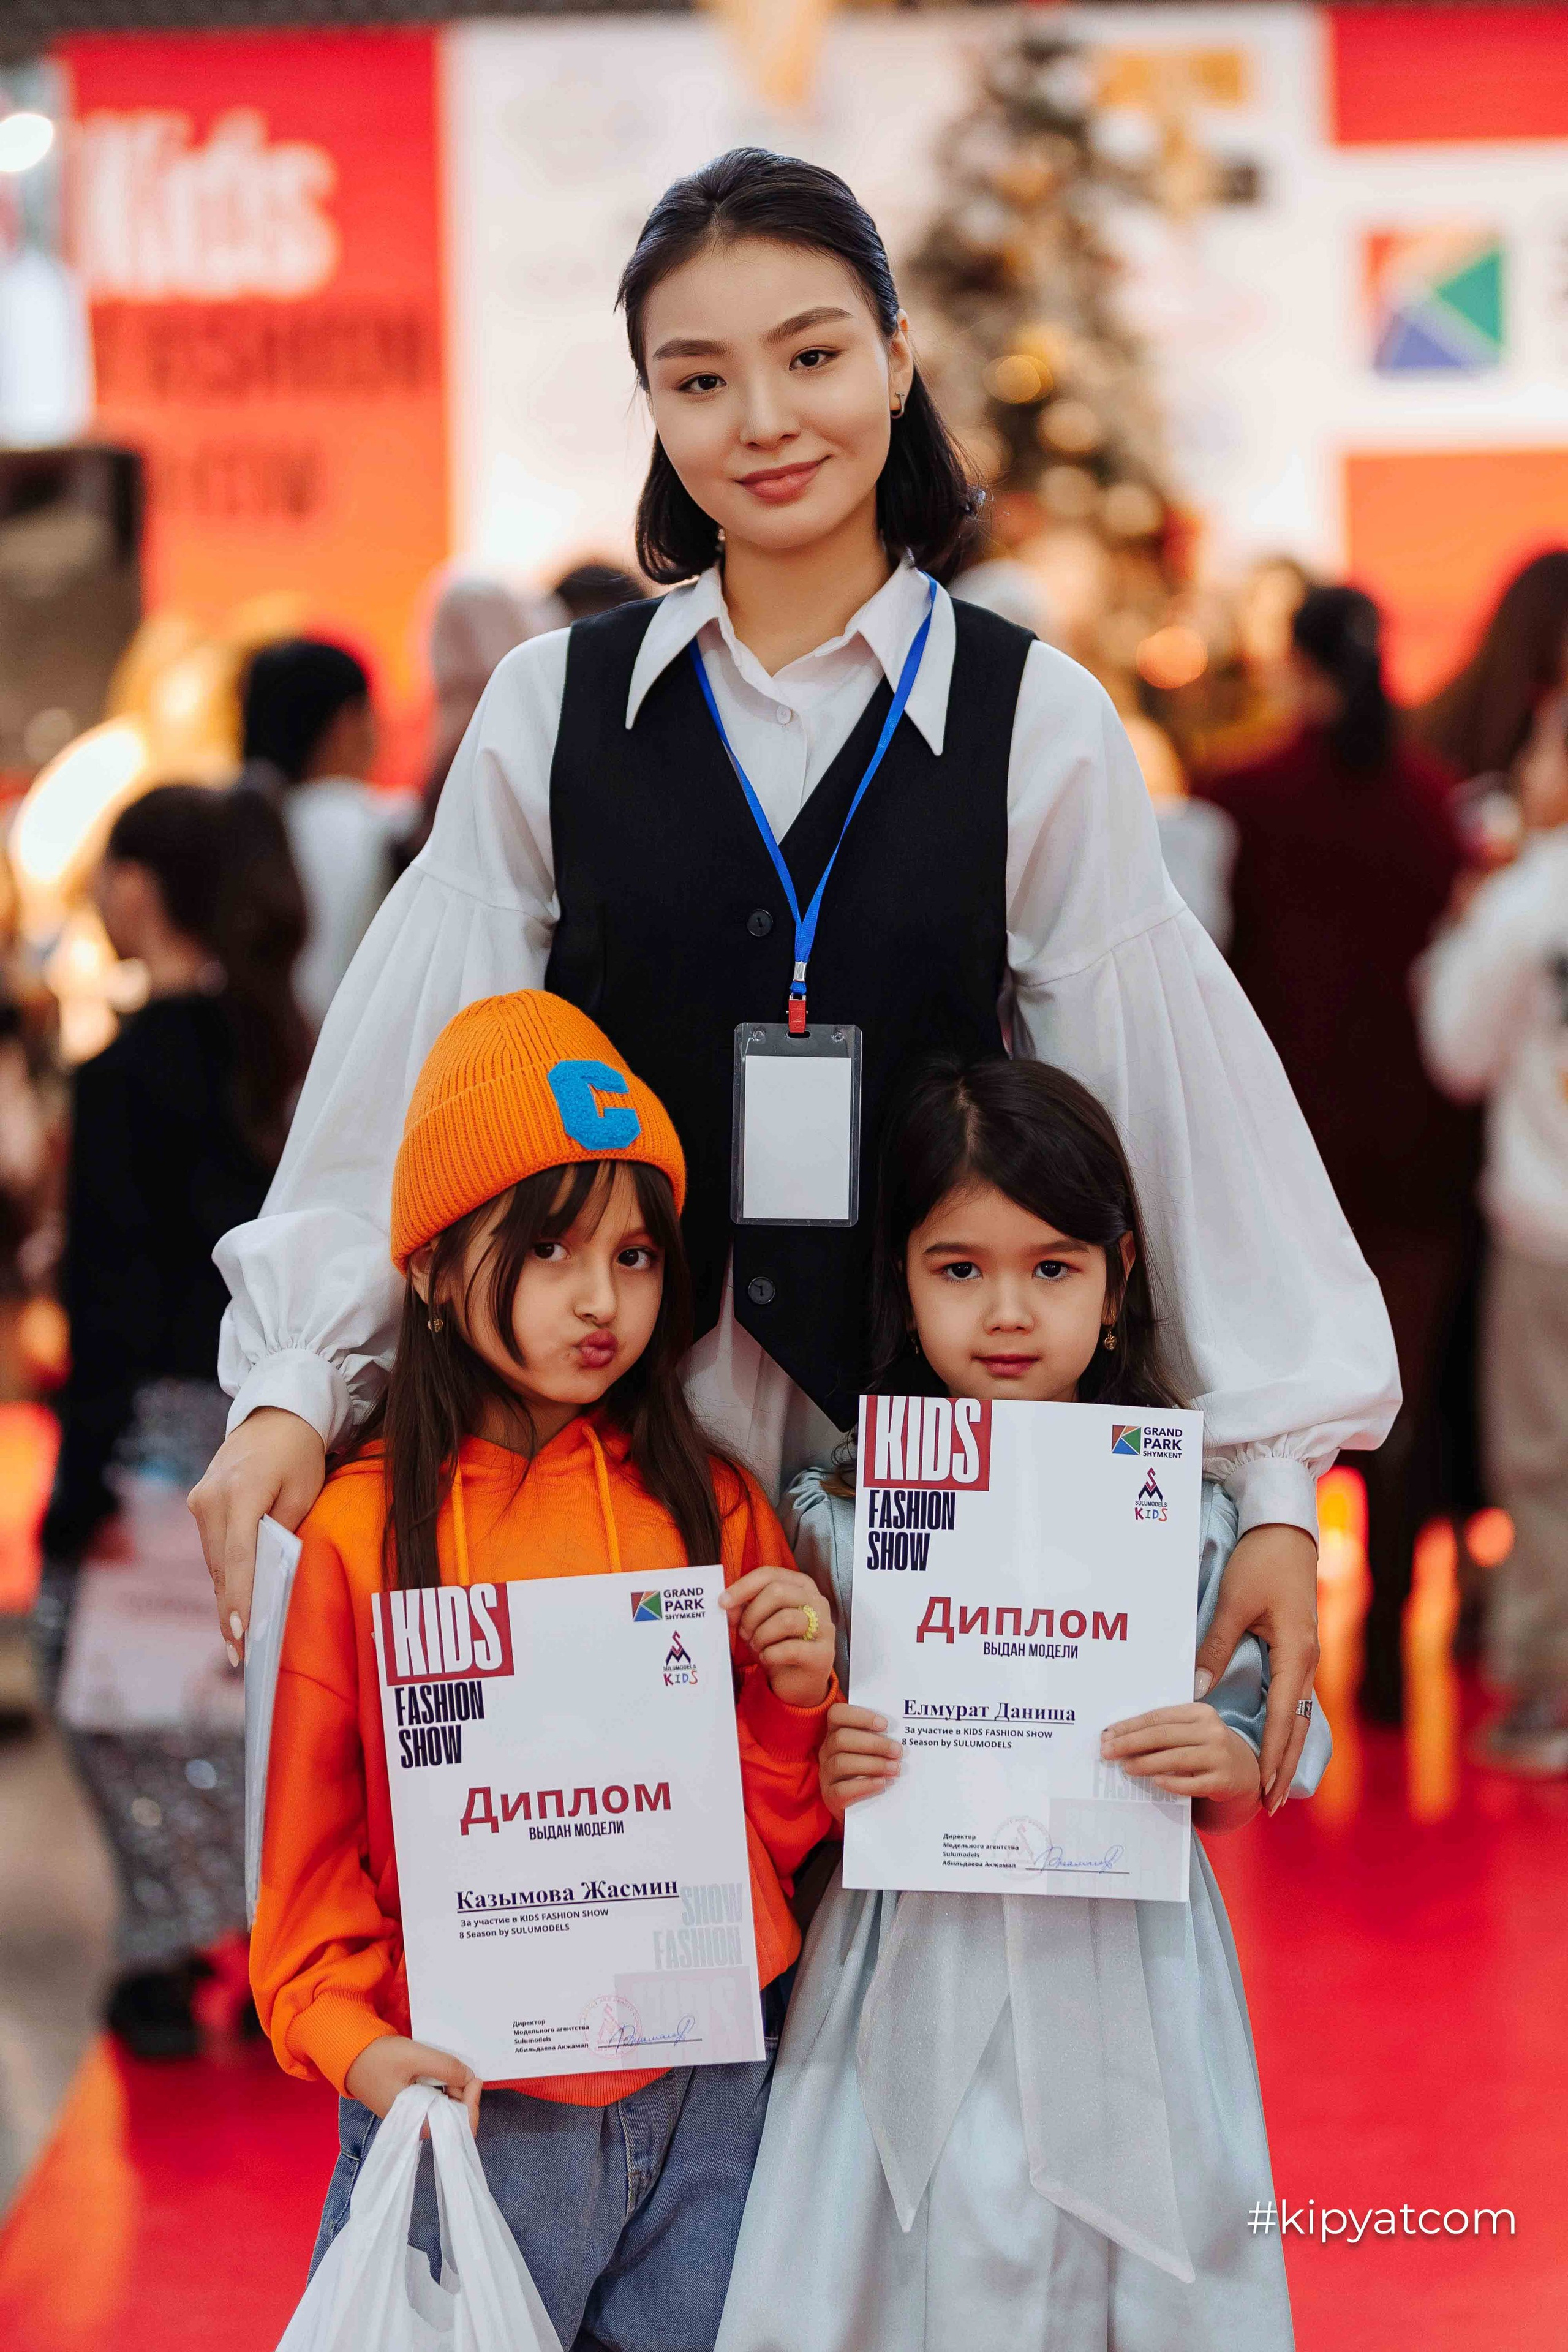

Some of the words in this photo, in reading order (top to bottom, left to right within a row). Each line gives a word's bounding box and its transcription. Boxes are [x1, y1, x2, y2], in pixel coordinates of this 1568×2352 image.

[547, 1060, 642, 1151] C
[873, 1396, 981, 1483] KIDS
[1144, 1427, 1183, 1437] GRAND
[1144, 1438, 1182, 1450] PARK
[868, 1489, 956, 1530] FASHION
[1135, 1507, 1168, 1521] KIDS
[867, 1531, 930, 1571] SHOW
[663, 1587, 704, 1598] GRAND
[665, 1598, 704, 1612] PARK
[665, 1611, 706, 1620] SHYMKENT
[916, 1596, 1128, 1644] Диплом
[390, 1583, 503, 1678] KIDS
[983, 1642, 1026, 1657] ВЫДАН
[1028, 1643, 1079, 1659] МОДЕЛИ
[663, 1669, 698, 1687] KIDS
[395, 1680, 485, 1726] FASHION
[903, 1699, 990, 1721] Елмурат
[994, 1702, 1076, 1722] Даниша
[918, 1727, 954, 1736] участие
[986, 1728, 1024, 1738] FASHION
[1026, 1730, 1054, 1739] SHOW
[398, 1725, 462, 1769] SHOW
[941, 1739, 951, 1748] by
[953, 1740, 1012, 1749] SULUMODELS
[460, 1782, 672, 1836] Диплом
[529, 1823, 571, 1841] ВЫДАН
[574, 1820, 625, 1838] МОДЕЛИ
[456, 1887, 575, 1910] Казымова
[580, 1880, 677, 1900] Жасмин
[474, 1917, 510, 1928] участие
[541, 1911, 580, 1921] FASHION
[582, 1909, 609, 1918] SHOW
[466, 1930, 497, 1939] Season
[499, 1928, 509, 1937] by
[511, 1923, 570, 1936] SULUMODELS
[512, 2019, 546, 2028] Директор
[513, 2027, 555, 2036] Модельного
[514, 2036, 551, 2045] Sulumodels
